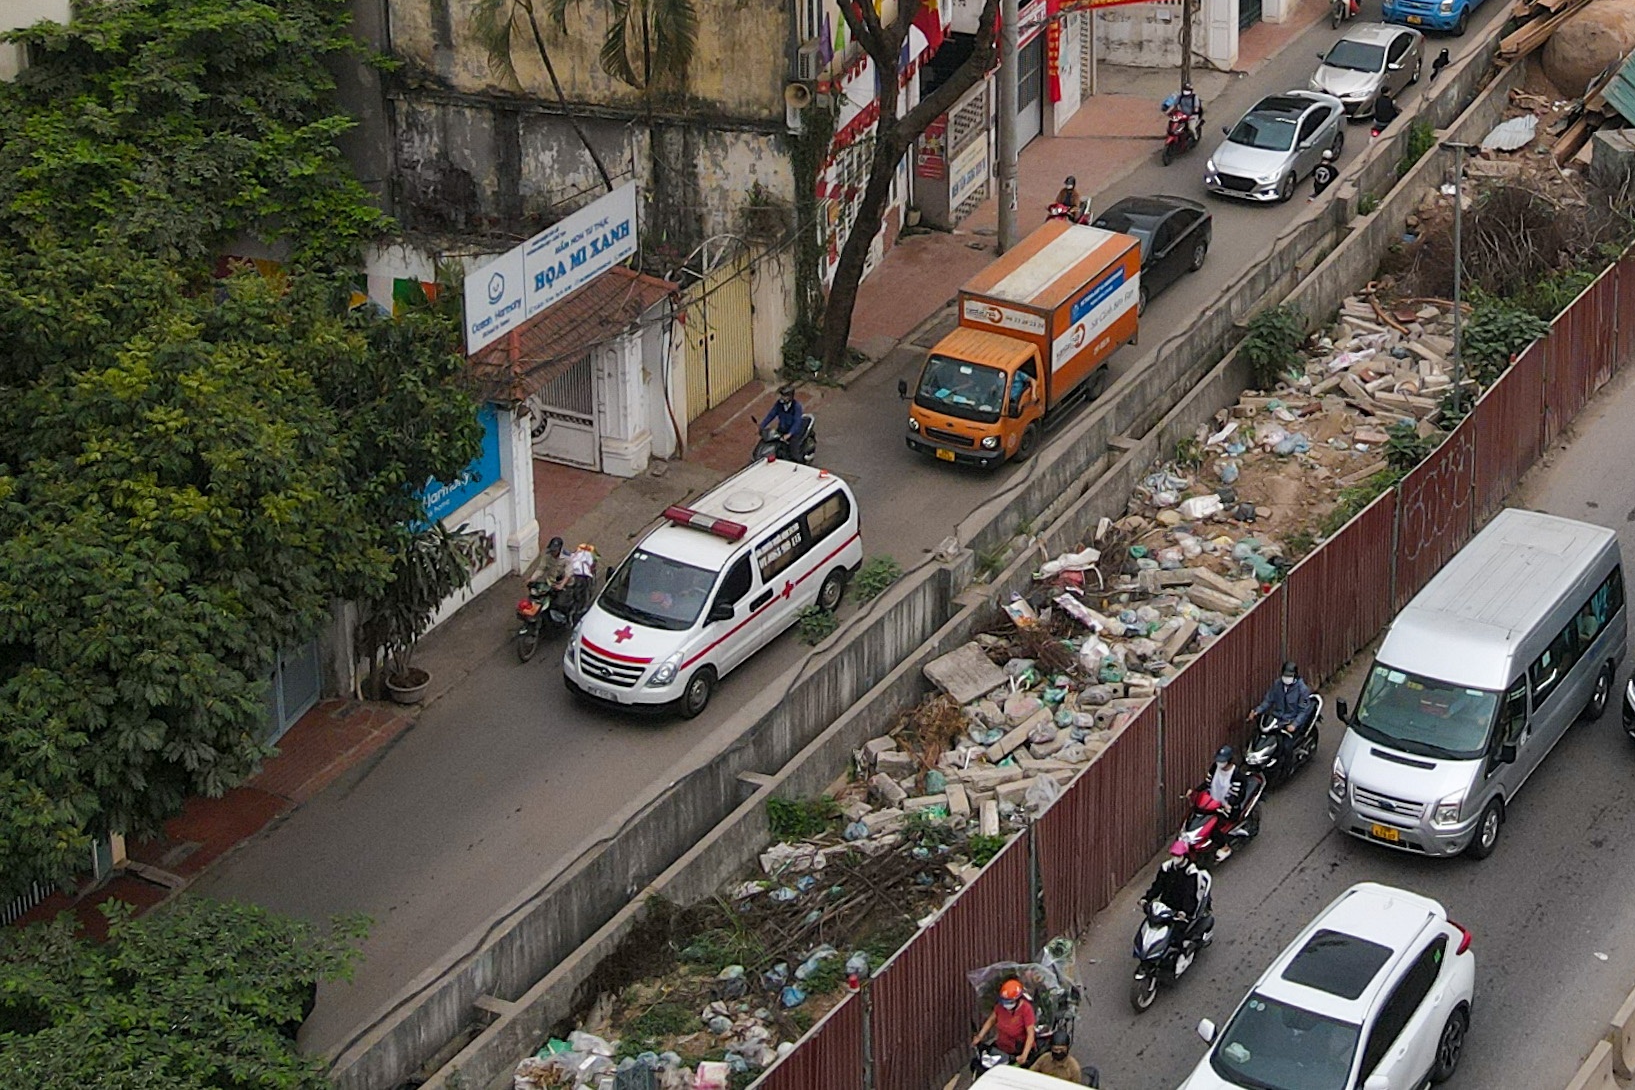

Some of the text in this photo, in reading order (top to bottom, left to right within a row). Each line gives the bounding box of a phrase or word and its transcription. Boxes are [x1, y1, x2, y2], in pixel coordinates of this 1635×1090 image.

[534, 261, 567, 293] HỌA
[569, 245, 588, 271] MI
[590, 219, 630, 259] XANH
